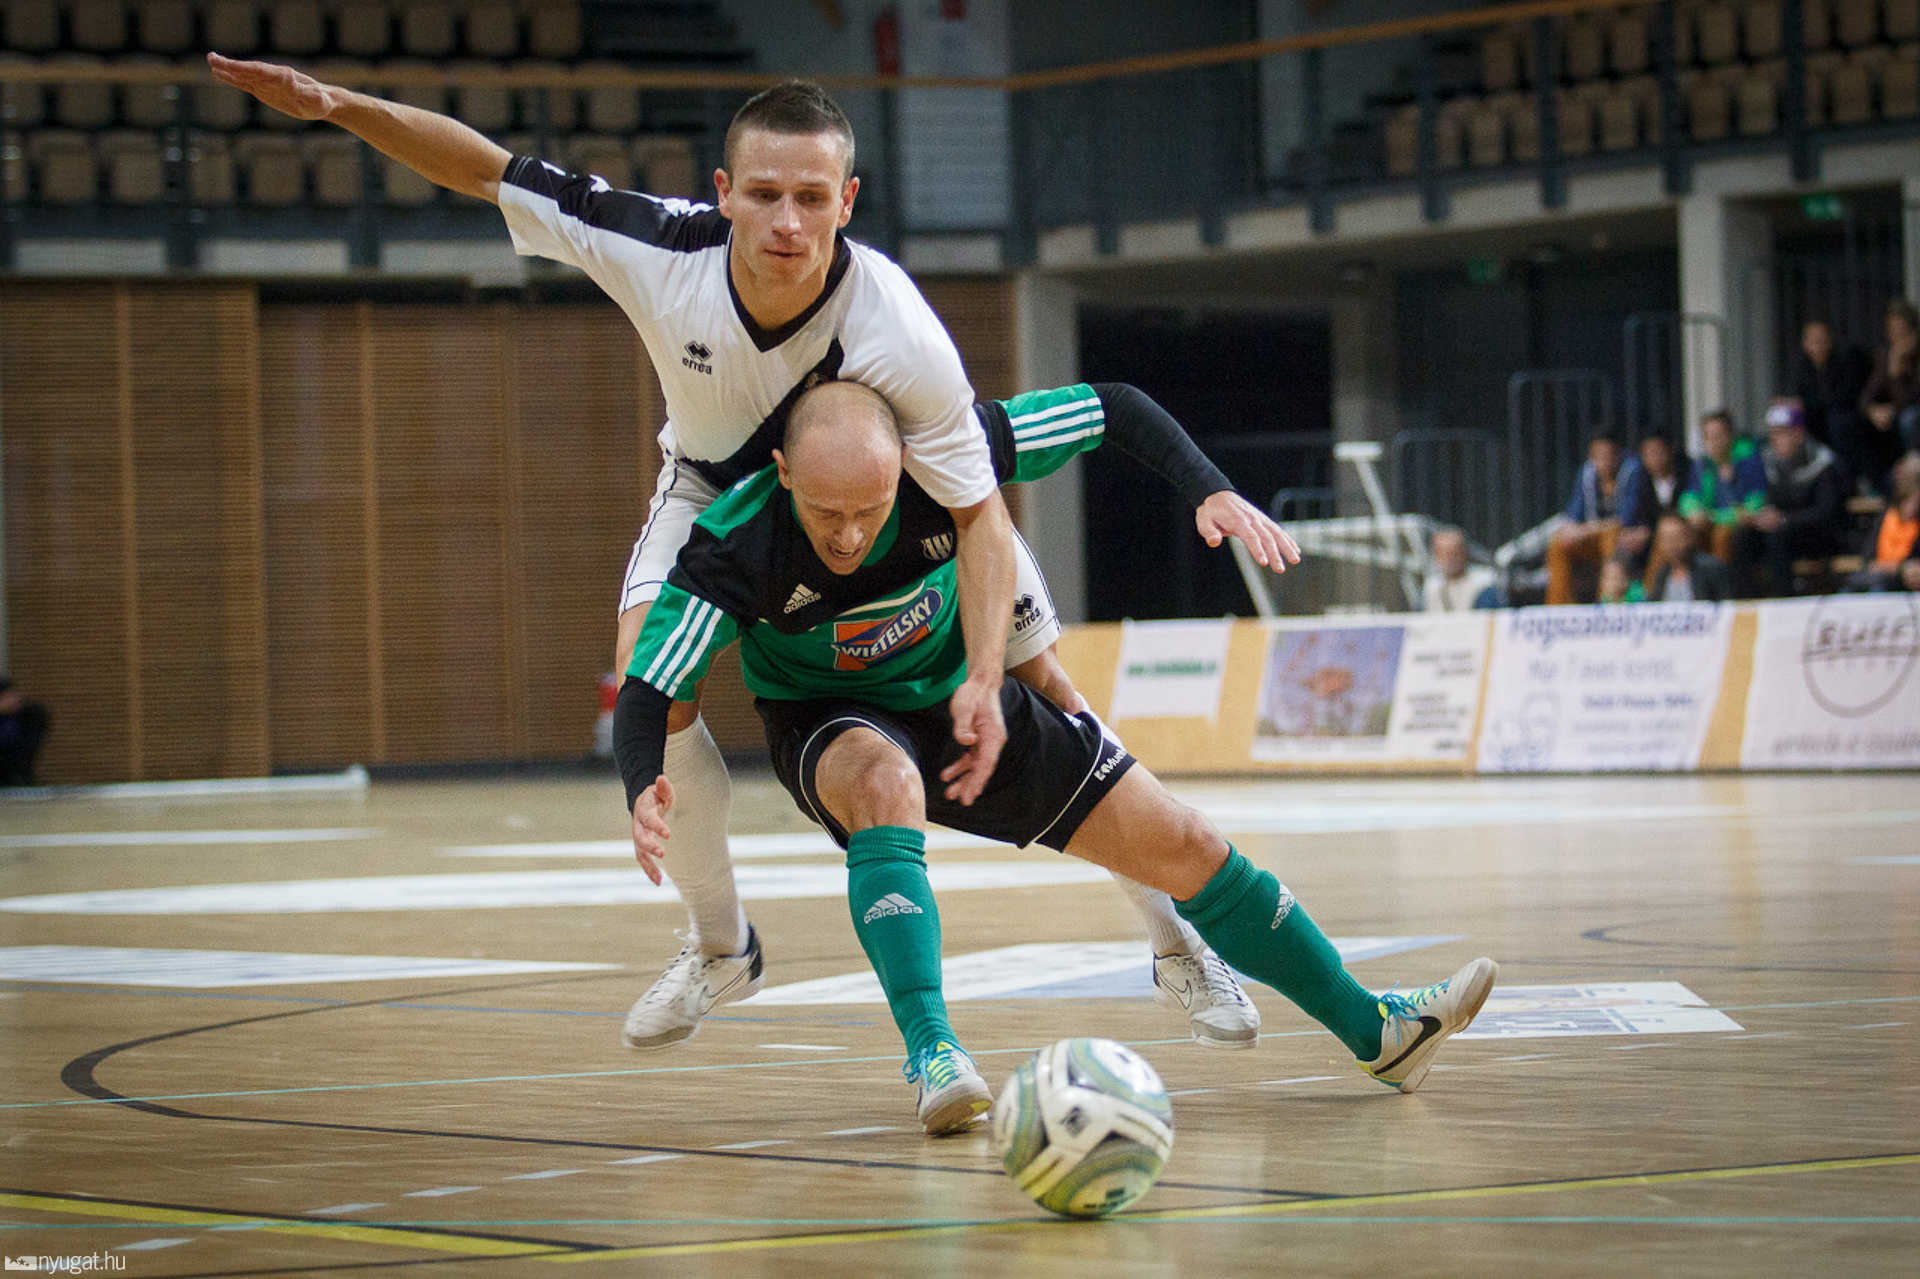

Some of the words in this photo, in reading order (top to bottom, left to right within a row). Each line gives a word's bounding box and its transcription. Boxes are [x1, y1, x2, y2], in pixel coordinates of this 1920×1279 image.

[784, 592, 821, 614] adidas
[840, 597, 932, 657] WIETELSKY
[863, 906, 923, 924] adidas
[1270, 898, 1295, 930] adid
